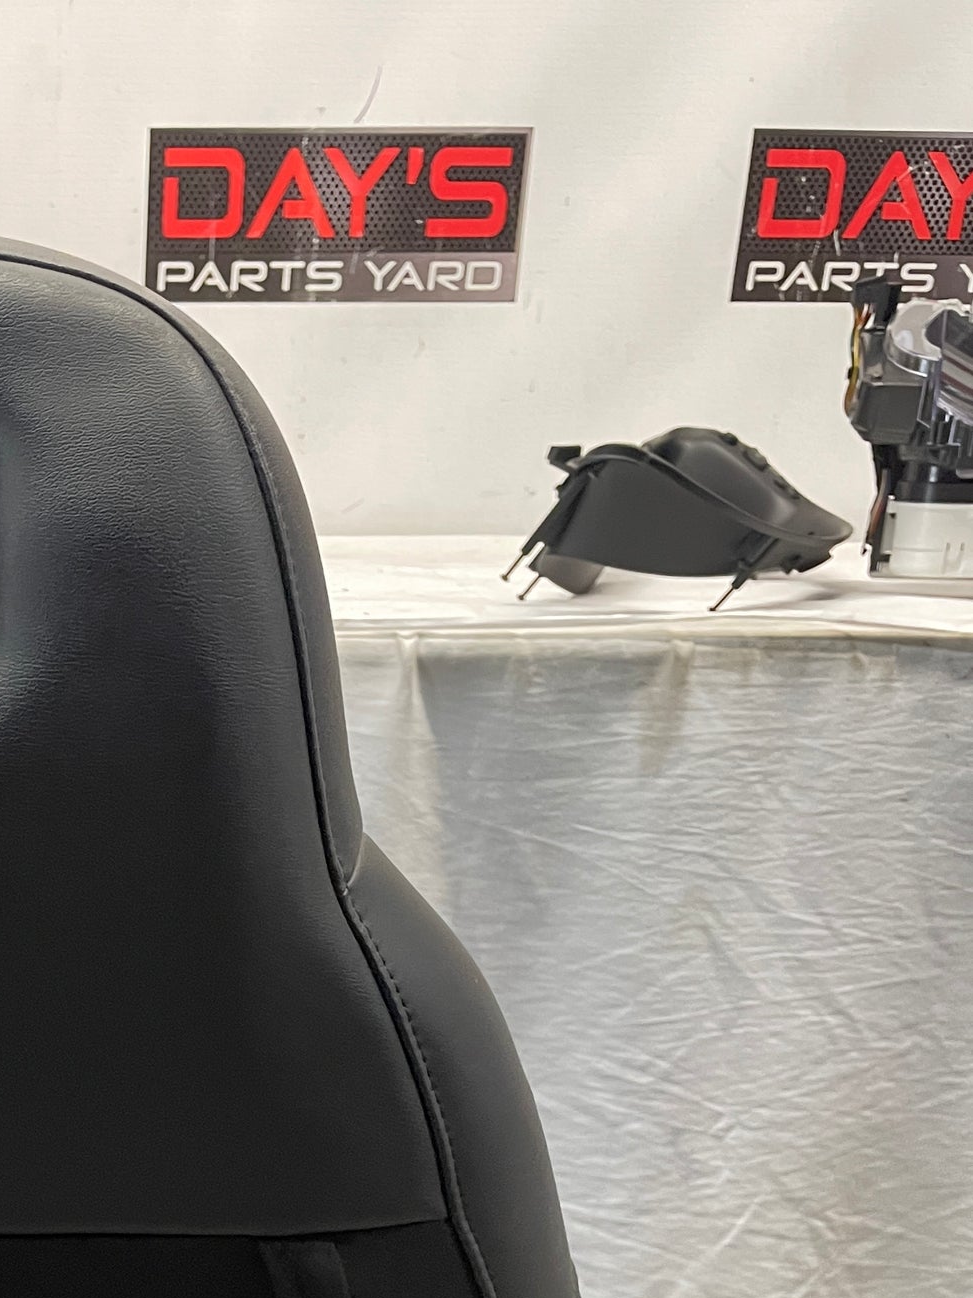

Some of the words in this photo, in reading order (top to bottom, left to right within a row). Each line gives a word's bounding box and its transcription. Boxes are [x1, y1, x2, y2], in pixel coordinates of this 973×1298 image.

[161, 147, 514, 239] DAY'S
[156, 260, 344, 292] PARTS
[363, 260, 503, 291] YARD
[745, 260, 938, 293] PARTS
